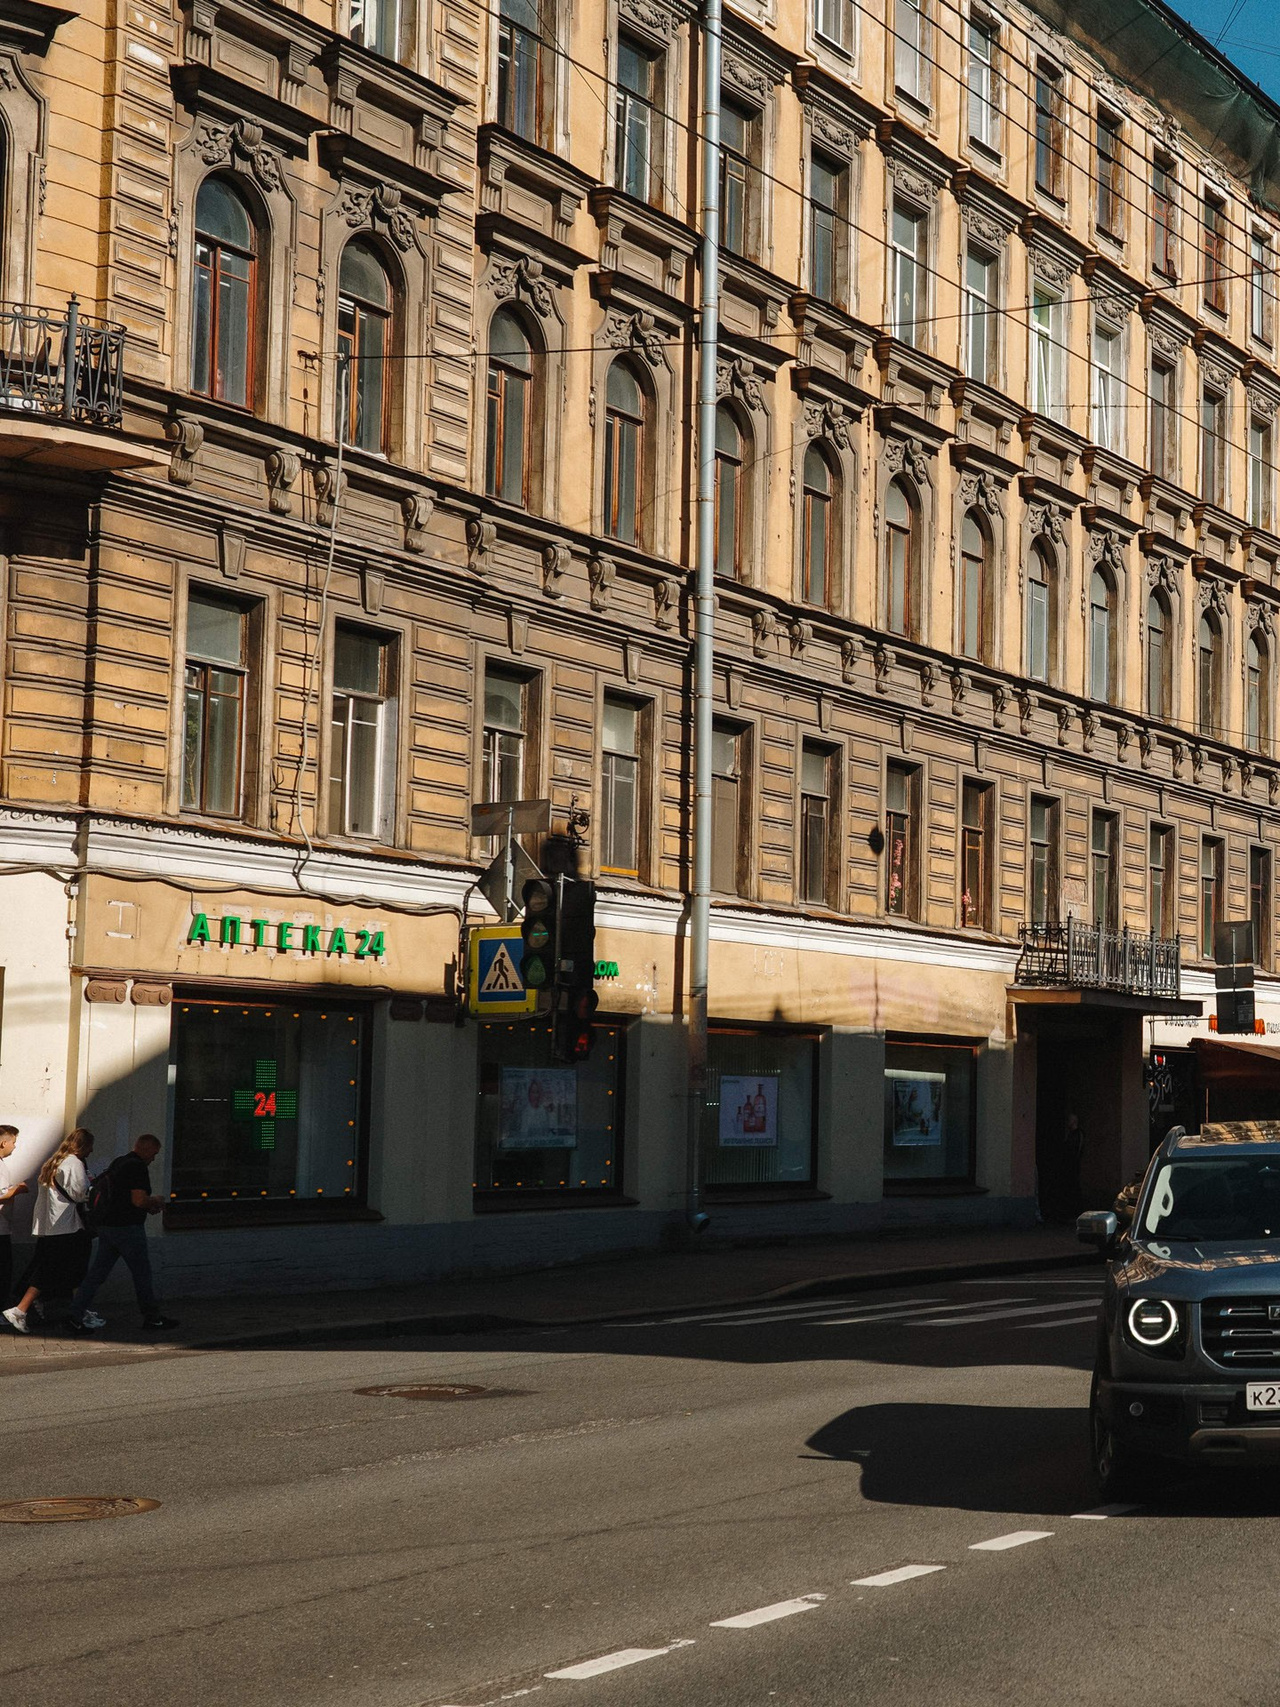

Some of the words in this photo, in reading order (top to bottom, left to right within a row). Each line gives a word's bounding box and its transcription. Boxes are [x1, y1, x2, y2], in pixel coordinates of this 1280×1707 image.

[188, 913, 347, 953] АПТЕКА
[357, 930, 386, 956] 24
[253, 1091, 277, 1117] 24
